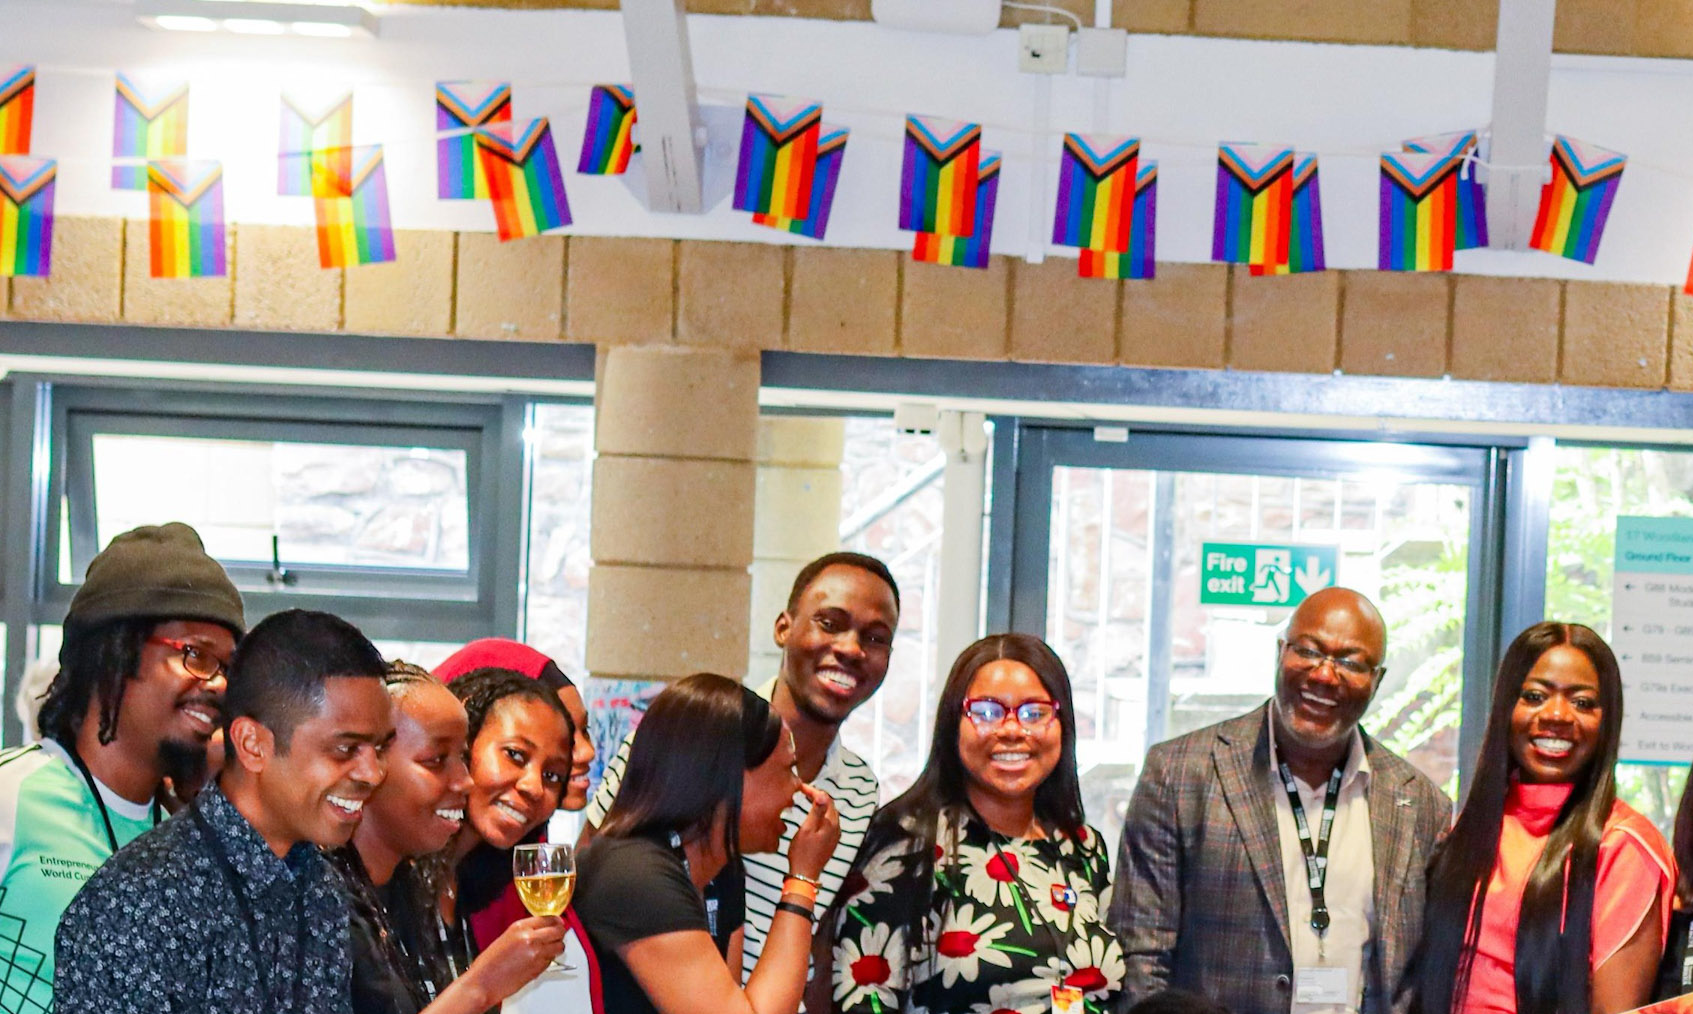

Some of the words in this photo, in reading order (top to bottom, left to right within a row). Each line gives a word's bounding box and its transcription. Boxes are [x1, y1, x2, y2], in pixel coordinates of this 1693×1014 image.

[1206, 552, 1248, 573] Fire
[1625, 550, 1662, 562] Ground
[1664, 551, 1691, 563] Floor
[1206, 575, 1246, 594] exit
[1640, 711, 1693, 722] Accessible
[1638, 739, 1656, 751] Exit
[1659, 741, 1669, 751] to
[40, 868, 72, 879] World
